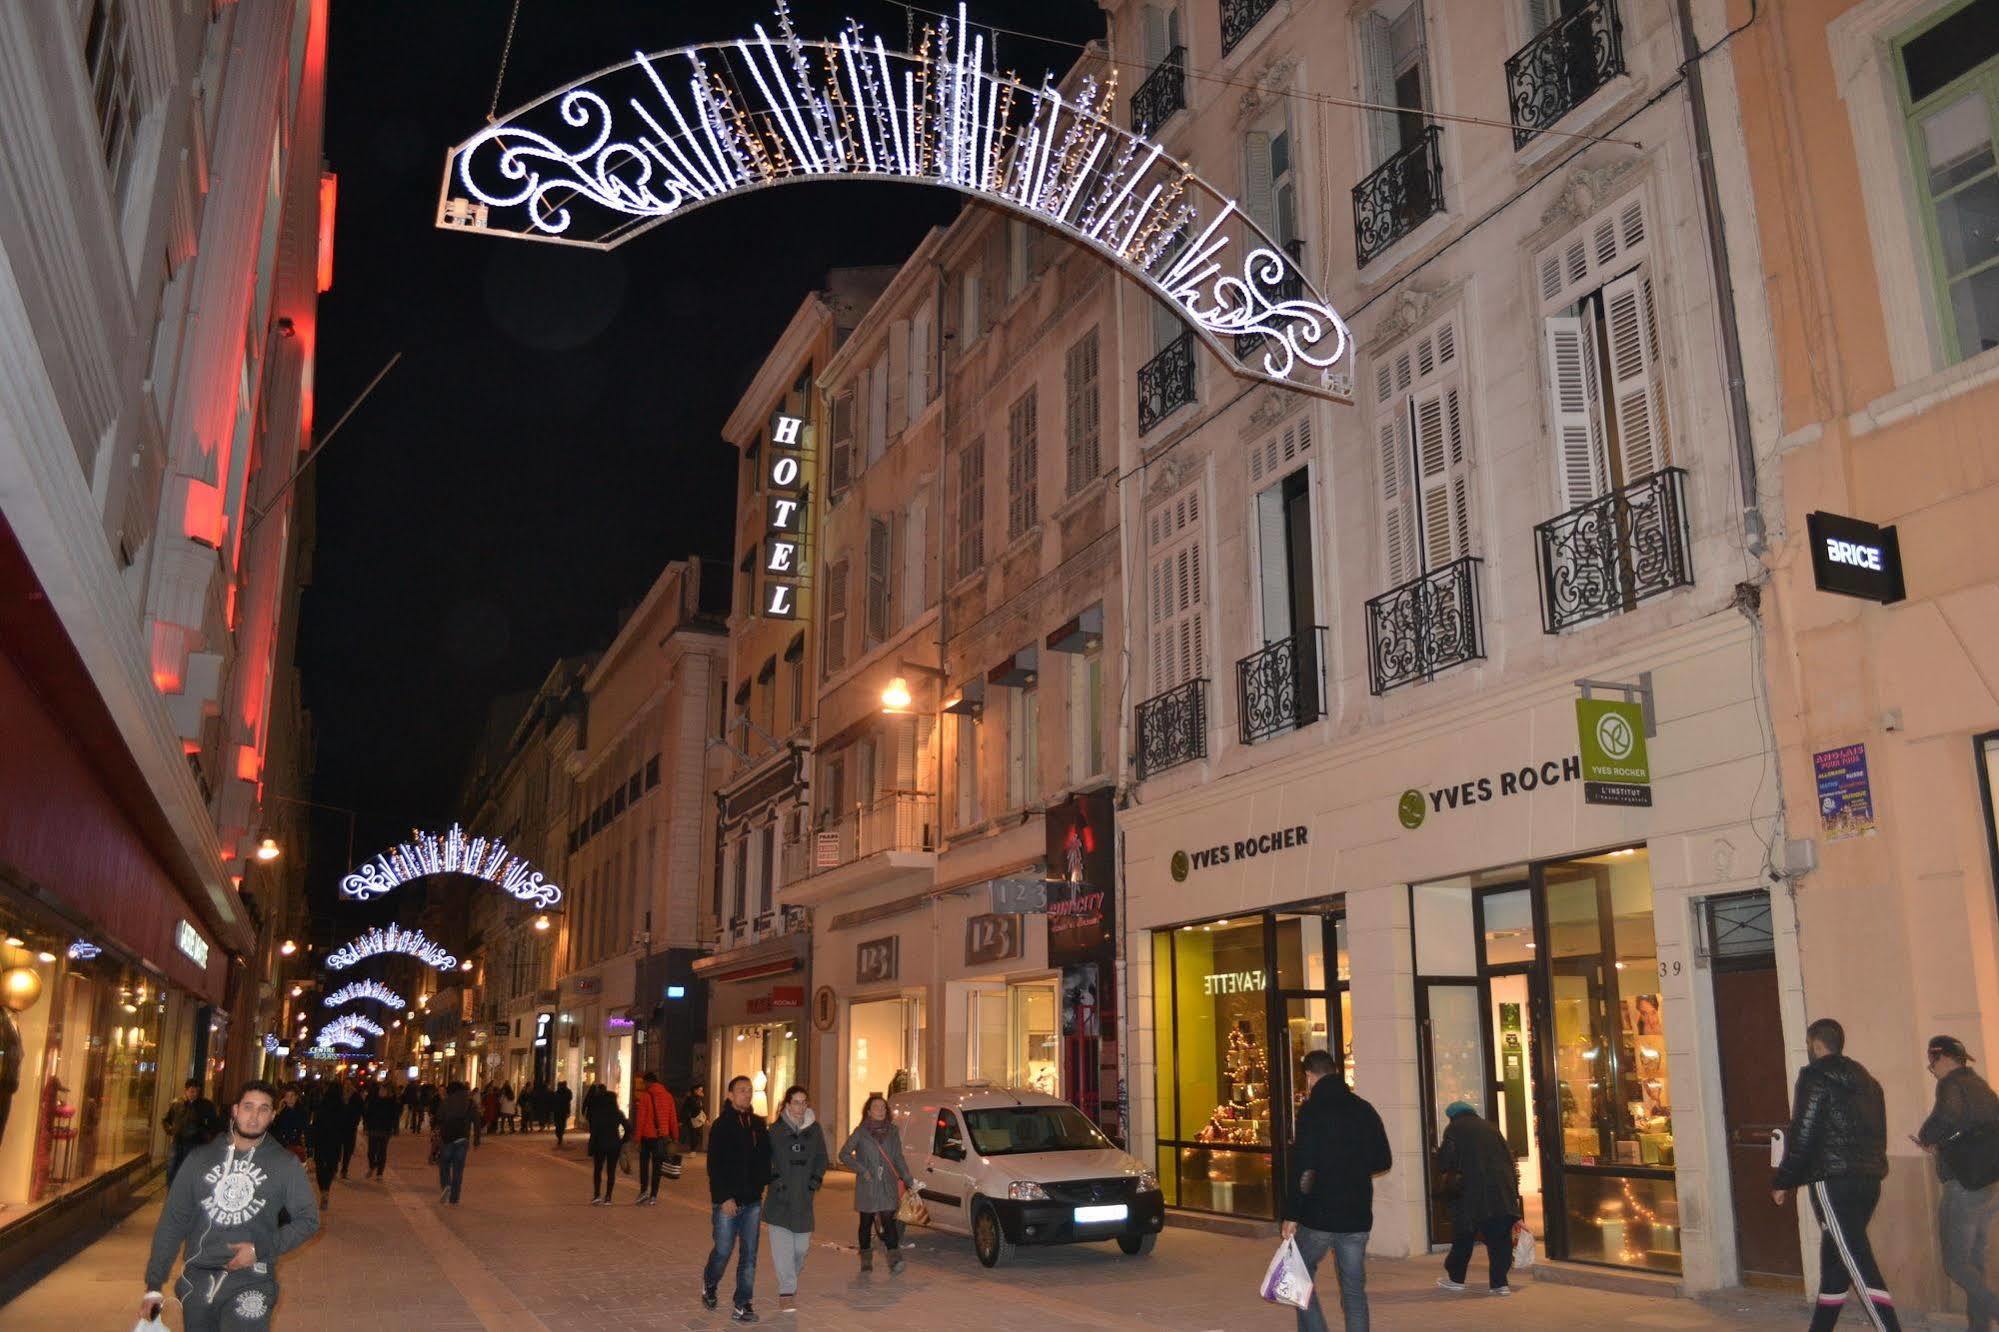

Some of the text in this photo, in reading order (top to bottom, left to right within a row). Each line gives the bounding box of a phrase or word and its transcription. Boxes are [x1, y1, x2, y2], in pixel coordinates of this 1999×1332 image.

[768, 416, 802, 615] HOTEL
[1826, 538, 1882, 571] BRICE
[1592, 765, 1647, 778] YVES ROCHER
[1429, 778, 1493, 812] YVES
[1601, 787, 1641, 797] L'INSTITUT
[1191, 825, 1308, 870] YVES ROCHER
[973, 917, 1011, 959] 123
[861, 944, 889, 978] 123
[1660, 960, 1681, 977] 39
[201, 1196, 266, 1225] MARSHALL
